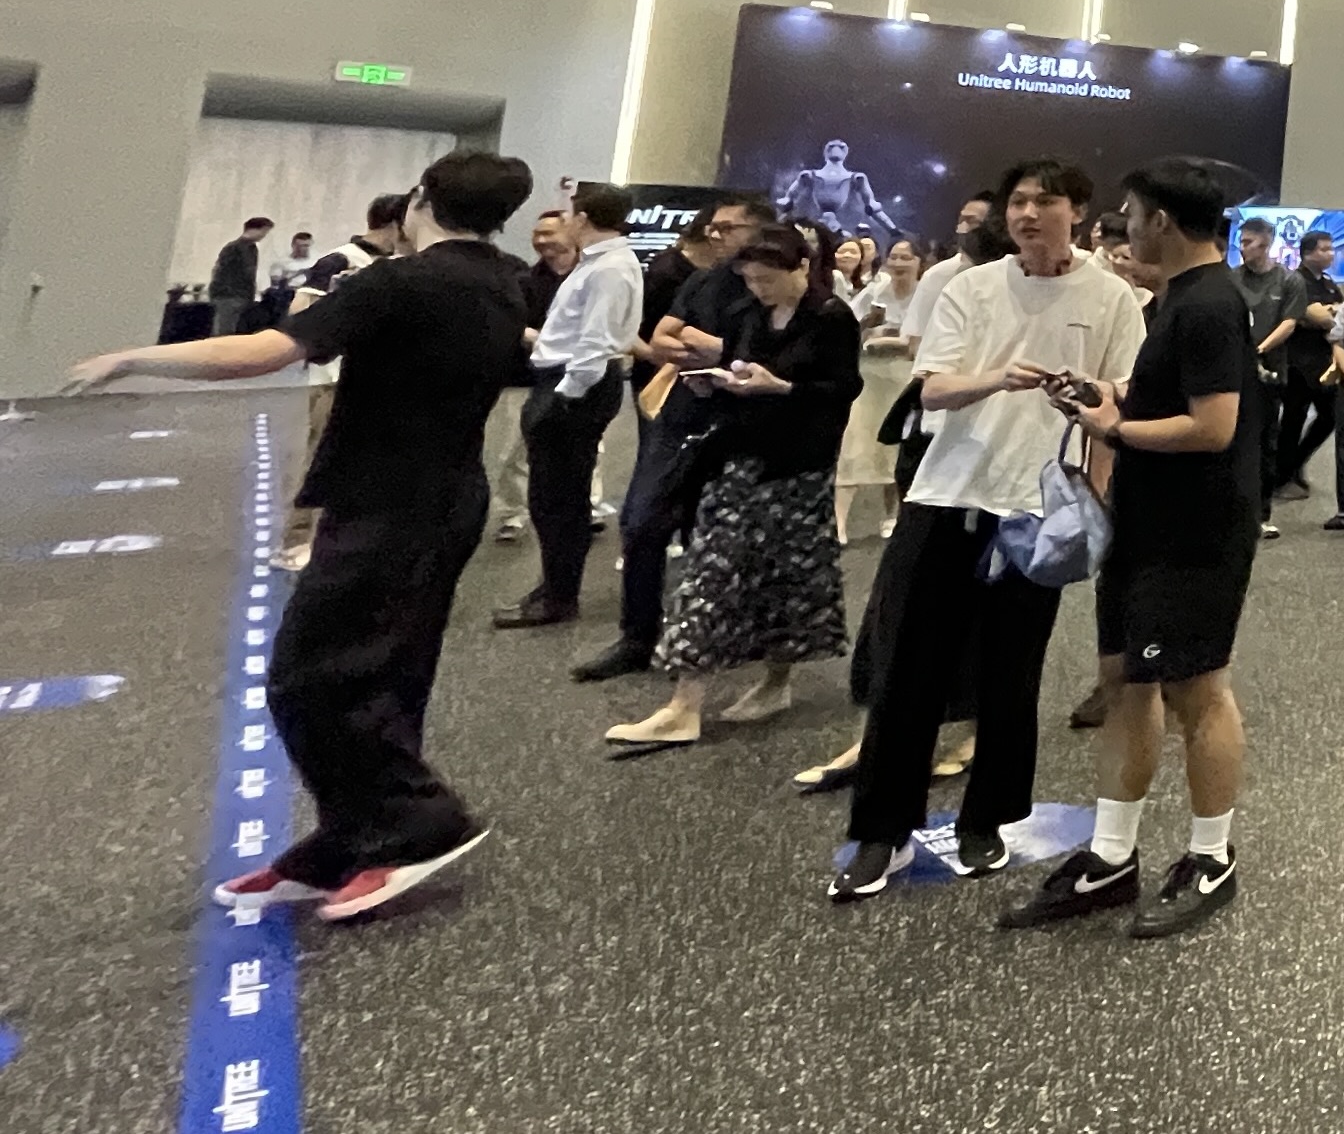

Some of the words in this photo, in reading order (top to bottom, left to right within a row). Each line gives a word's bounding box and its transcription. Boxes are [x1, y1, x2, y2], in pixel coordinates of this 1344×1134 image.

[997, 52, 1098, 82] 人形机器人
[957, 72, 1012, 91] Unitree
[1014, 77, 1089, 97] Humanoid
[1090, 84, 1132, 101] Robot
